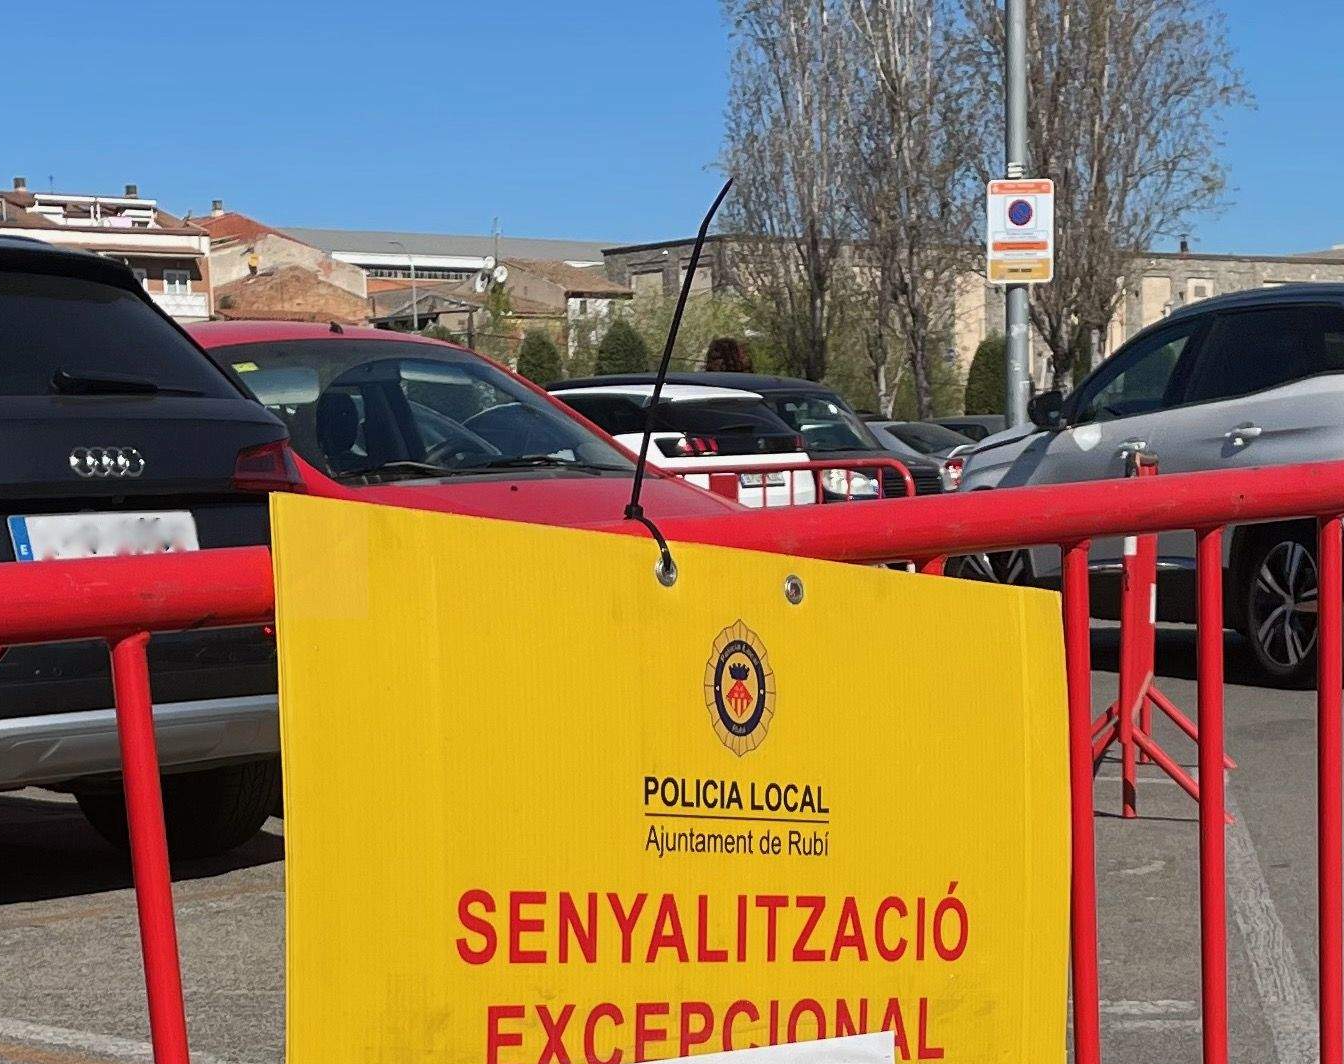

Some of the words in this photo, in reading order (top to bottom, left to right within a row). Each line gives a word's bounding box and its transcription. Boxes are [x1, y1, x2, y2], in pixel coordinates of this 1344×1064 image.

[644, 776, 744, 810] POLICIA
[750, 782, 830, 814] LOCAL
[645, 824, 754, 859] Ajuntament
[759, 829, 782, 855] de
[788, 829, 830, 856] Rubí
[455, 881, 969, 966] SENYALITZACIÓ
